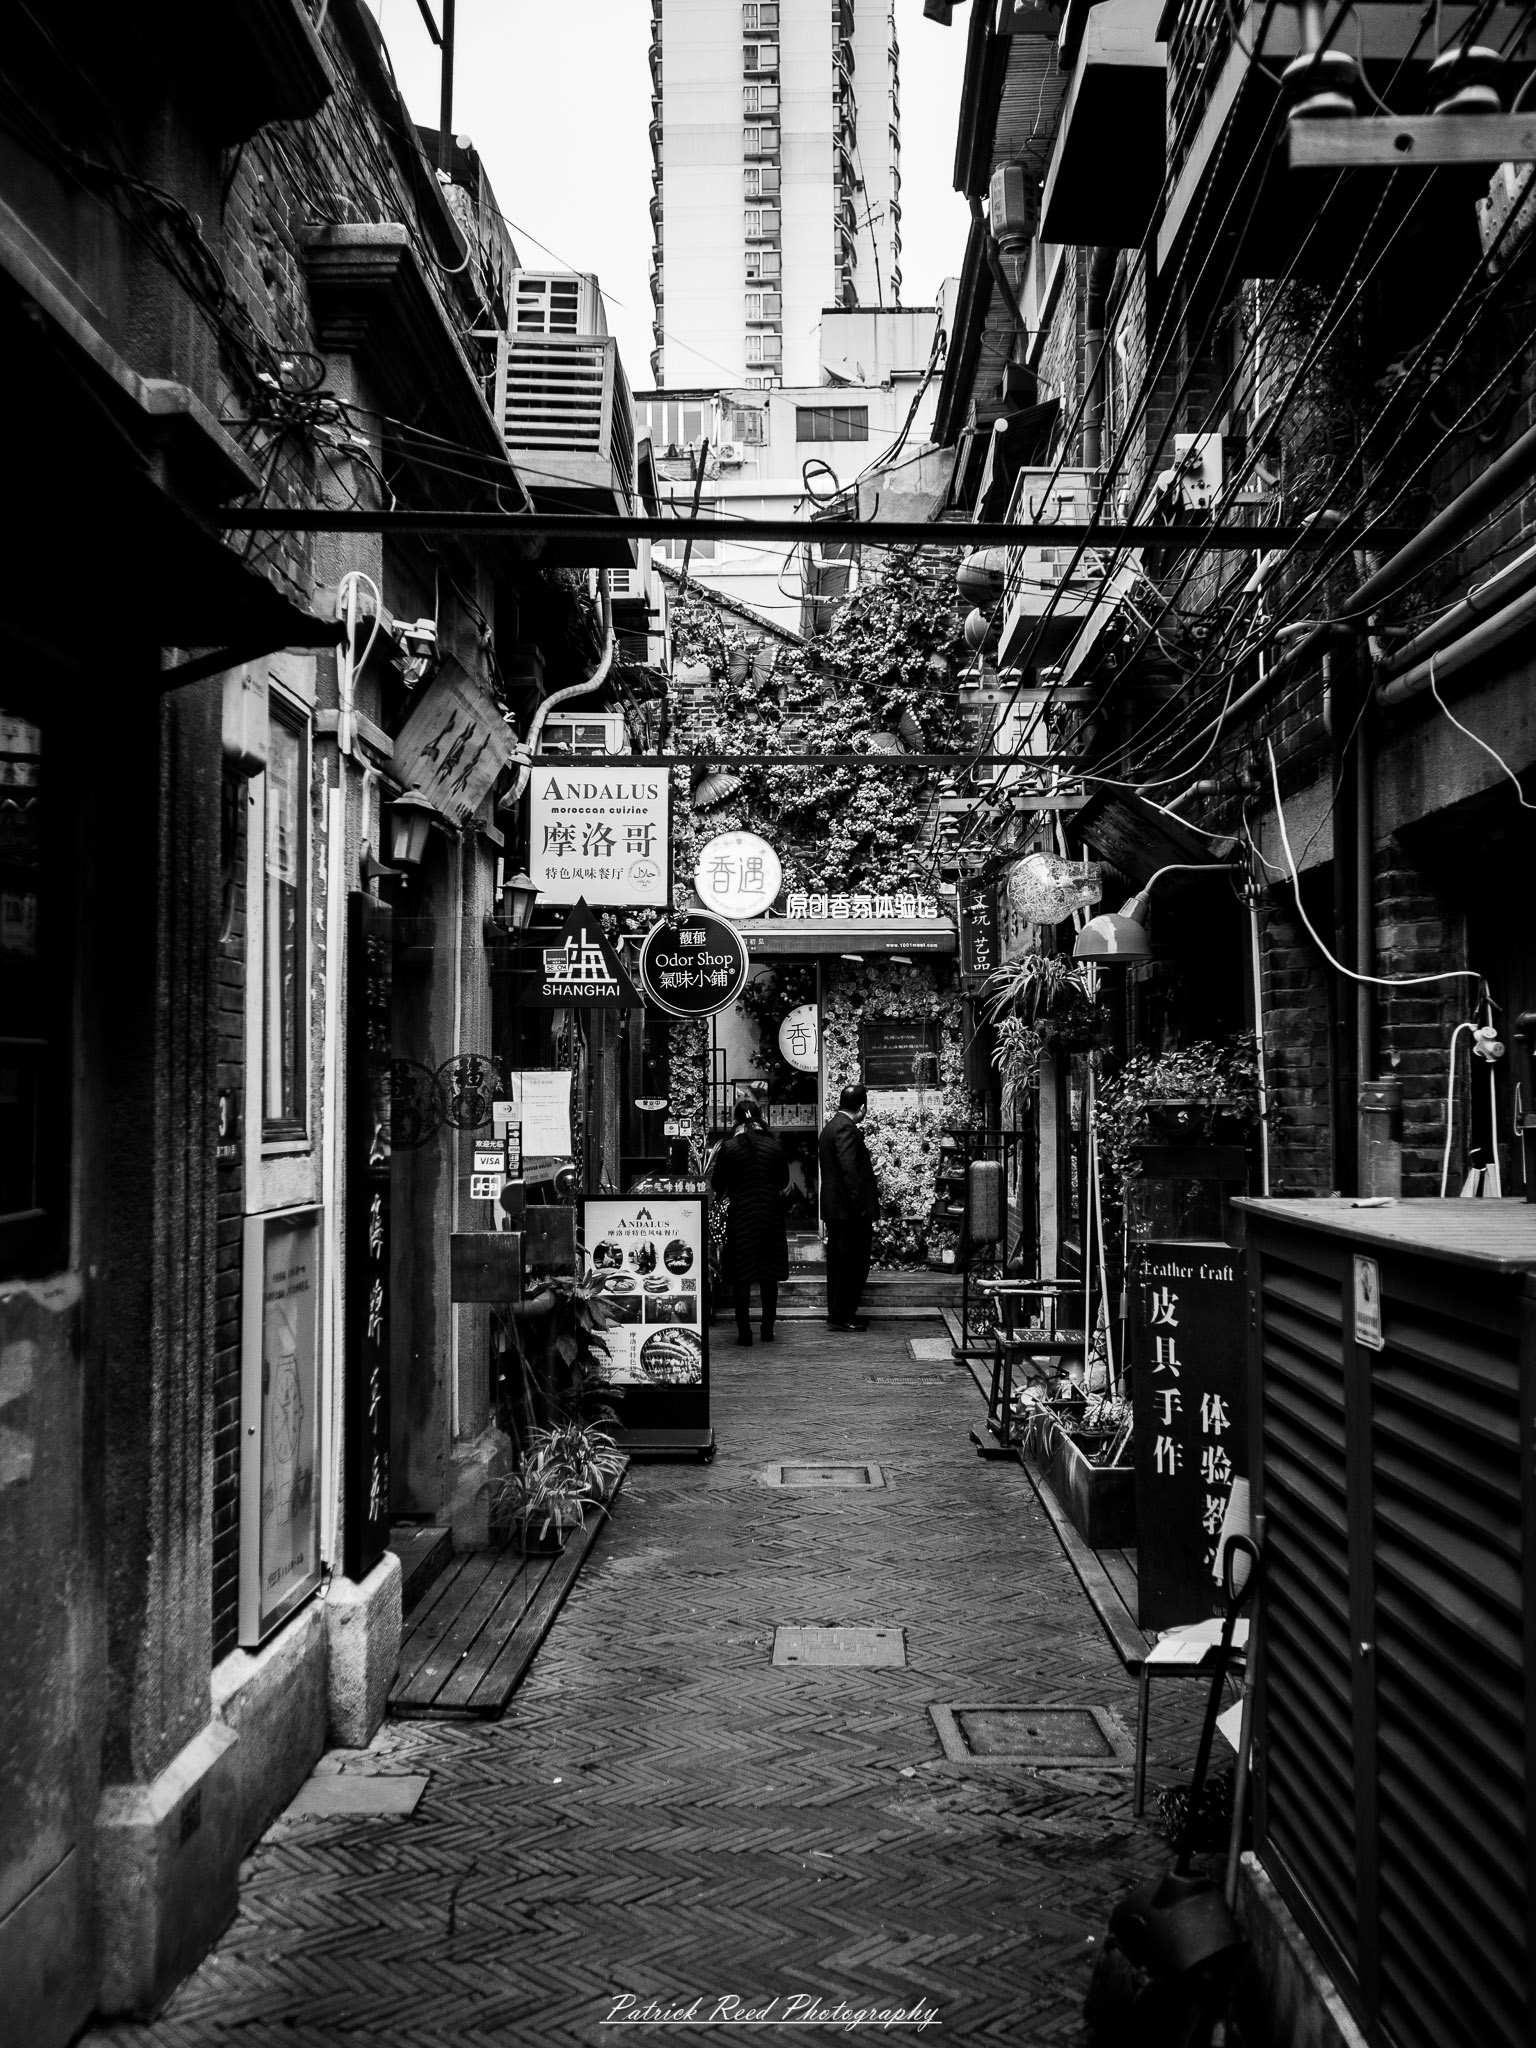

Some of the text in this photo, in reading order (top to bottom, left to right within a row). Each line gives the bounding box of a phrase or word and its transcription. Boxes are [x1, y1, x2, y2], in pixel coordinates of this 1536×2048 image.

[542, 776, 659, 800] ANDALUS
[551, 805, 649, 814] moroccan cuisine
[541, 821, 657, 858] 摩洛哥
[545, 867, 624, 880] 特色风味餐厅
[707, 855, 766, 894] 香遇
[679, 931, 706, 945] 馥郁
[655, 951, 733, 968] Odor Shop
[542, 984, 620, 996] SHANGHAI
[786, 1022, 818, 1055] 香
[480, 1157, 500, 1165] VISA
[617, 1218, 670, 1229] ANDALUS
[1200, 1263, 1234, 1281] Craft
[1150, 1286, 1184, 1476] 皮具手作
[1200, 1392, 1232, 1587] 体验教
